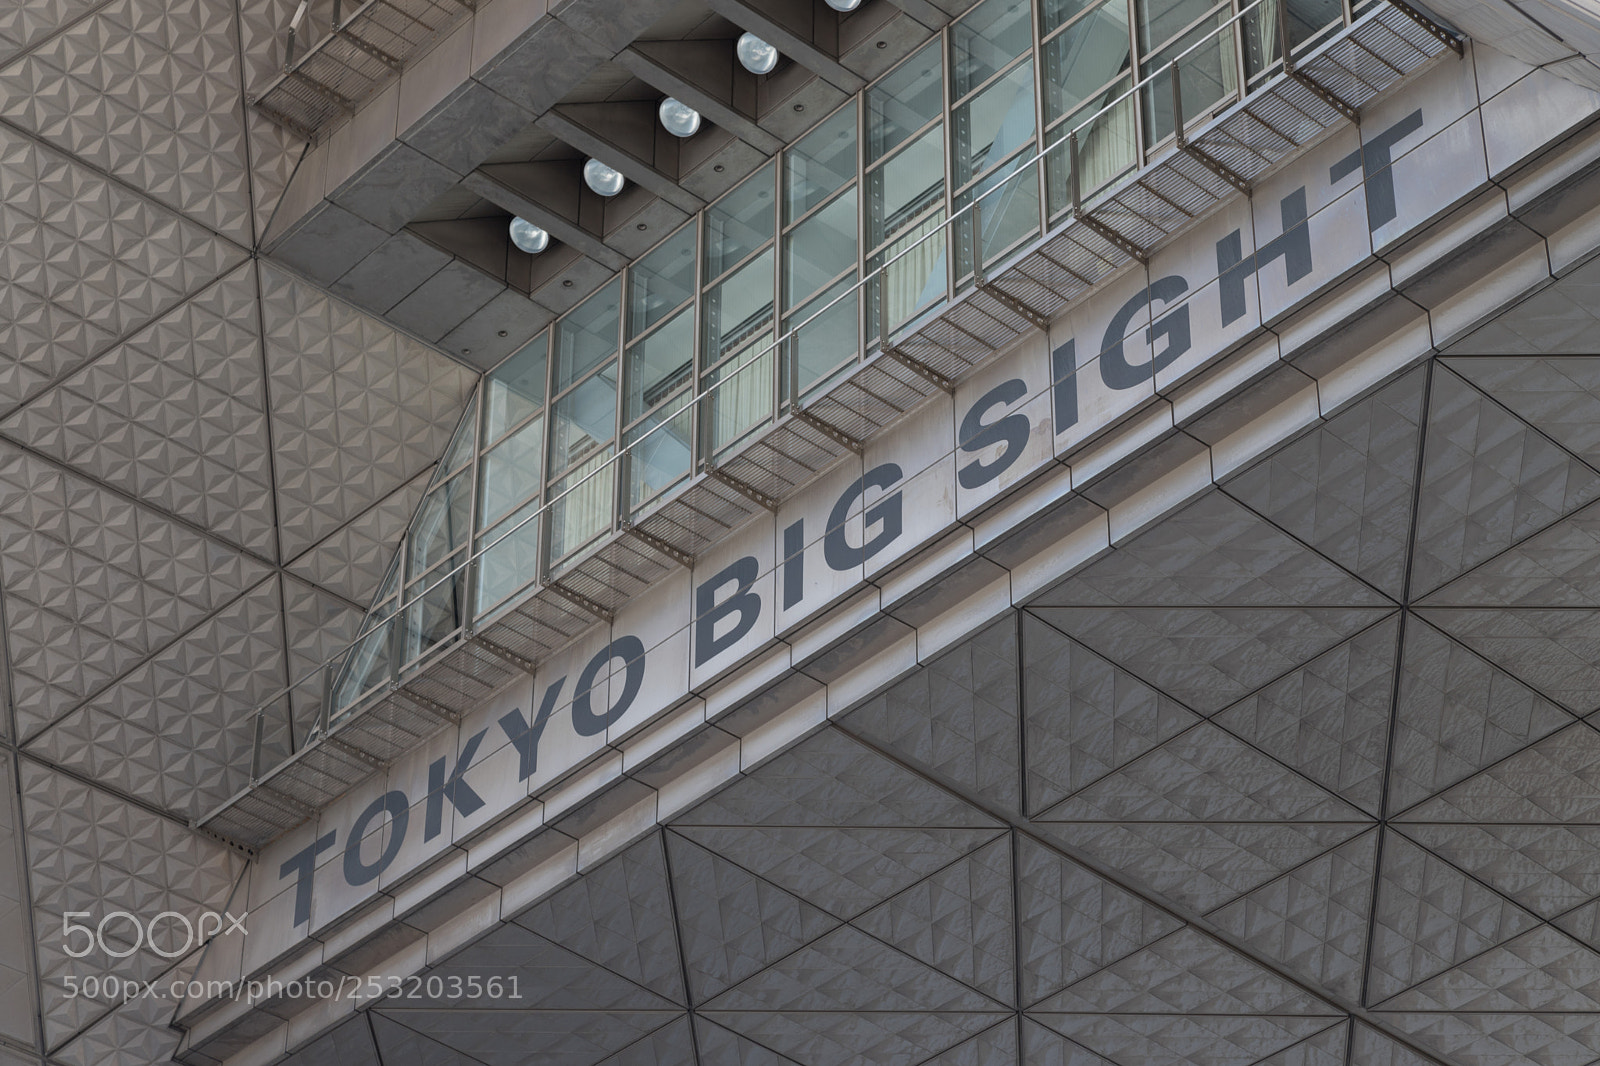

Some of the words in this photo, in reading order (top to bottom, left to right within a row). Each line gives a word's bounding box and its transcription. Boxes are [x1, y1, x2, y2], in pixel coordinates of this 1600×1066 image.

[279, 635, 646, 929] TOKYO
[695, 463, 903, 669] BIG
[958, 108, 1423, 490] SIGHT
